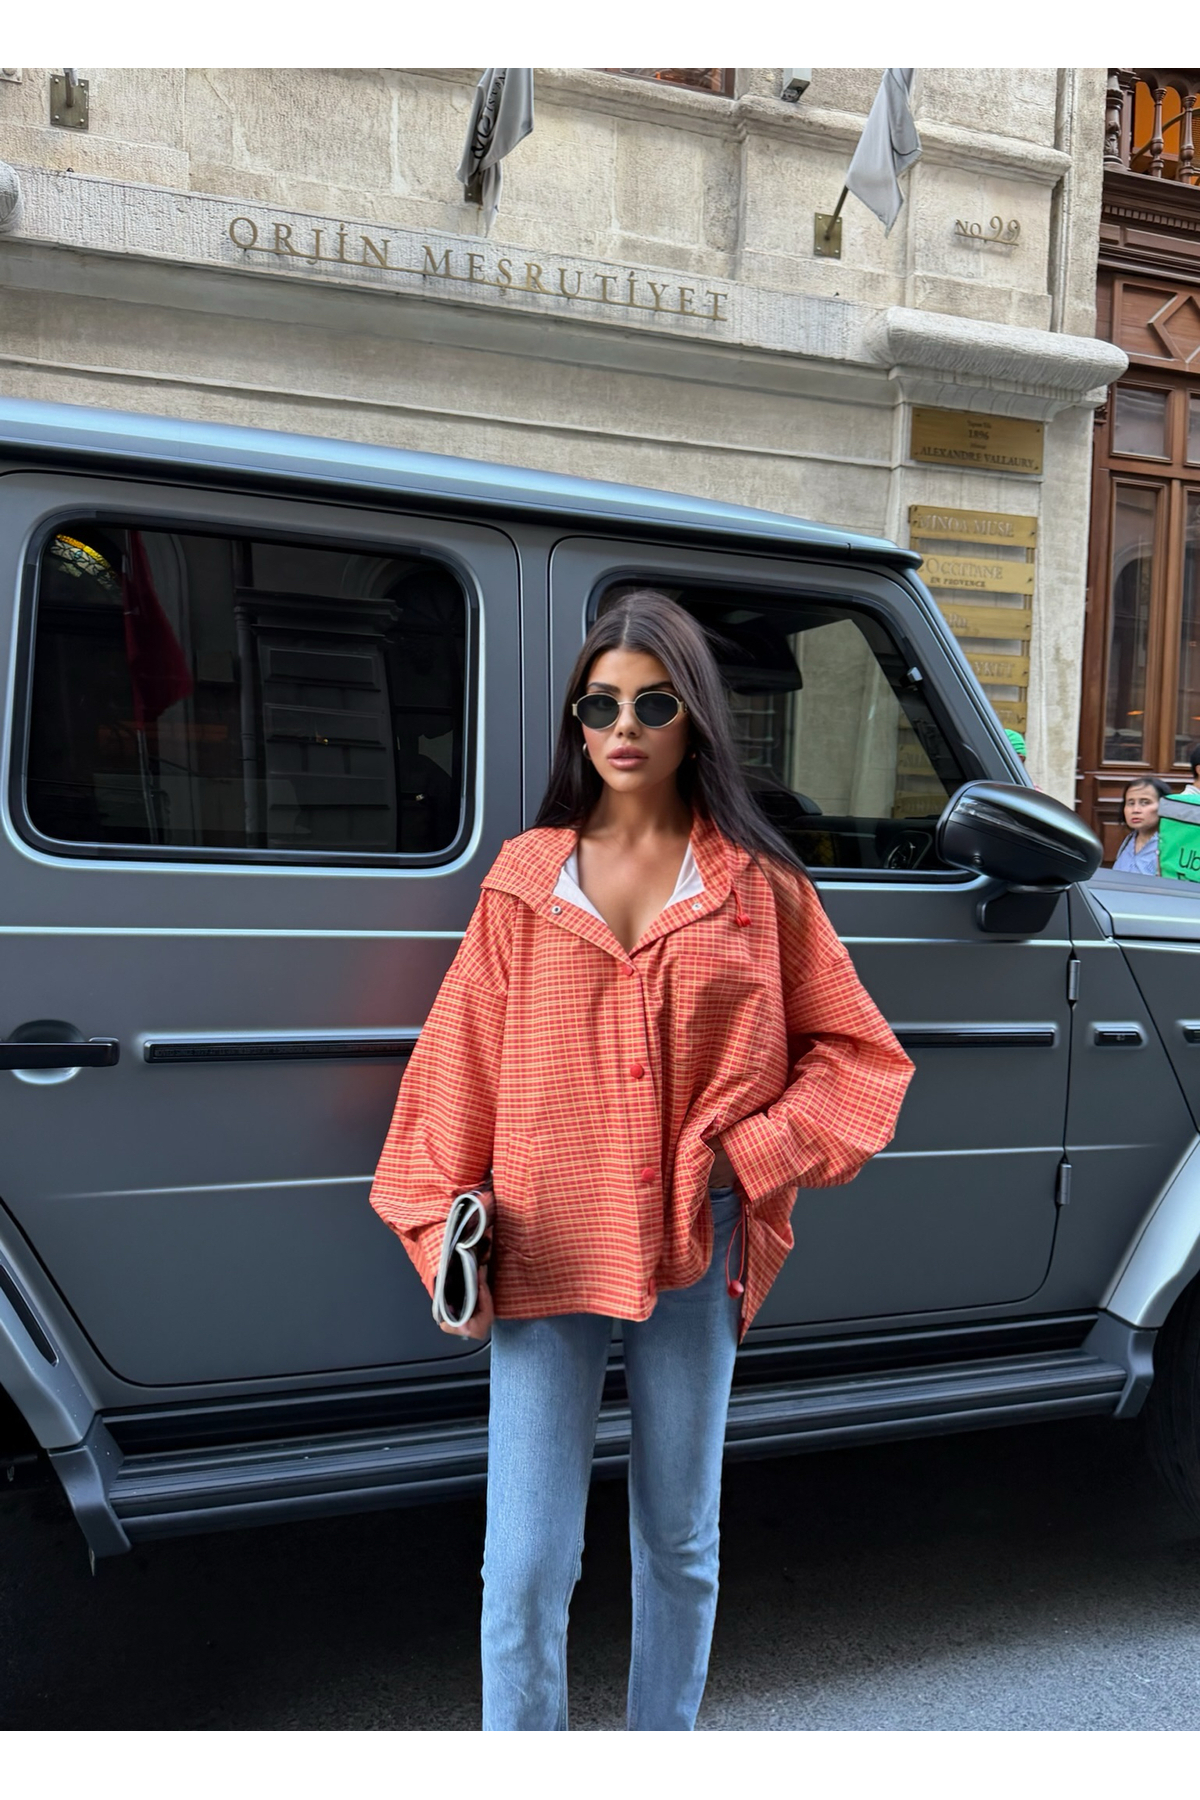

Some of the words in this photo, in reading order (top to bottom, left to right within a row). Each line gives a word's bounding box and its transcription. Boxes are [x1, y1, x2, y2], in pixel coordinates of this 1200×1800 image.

[989, 215, 1021, 244] 99
[228, 216, 391, 266] ORJİN
[422, 244, 729, 321] MEŞRUTİYET
[921, 446, 982, 463] ALEXANDRE
[983, 453, 1034, 468] VALLAURY
[918, 558, 1003, 579] OCCITANE
[943, 579, 986, 588] PROVENCE
